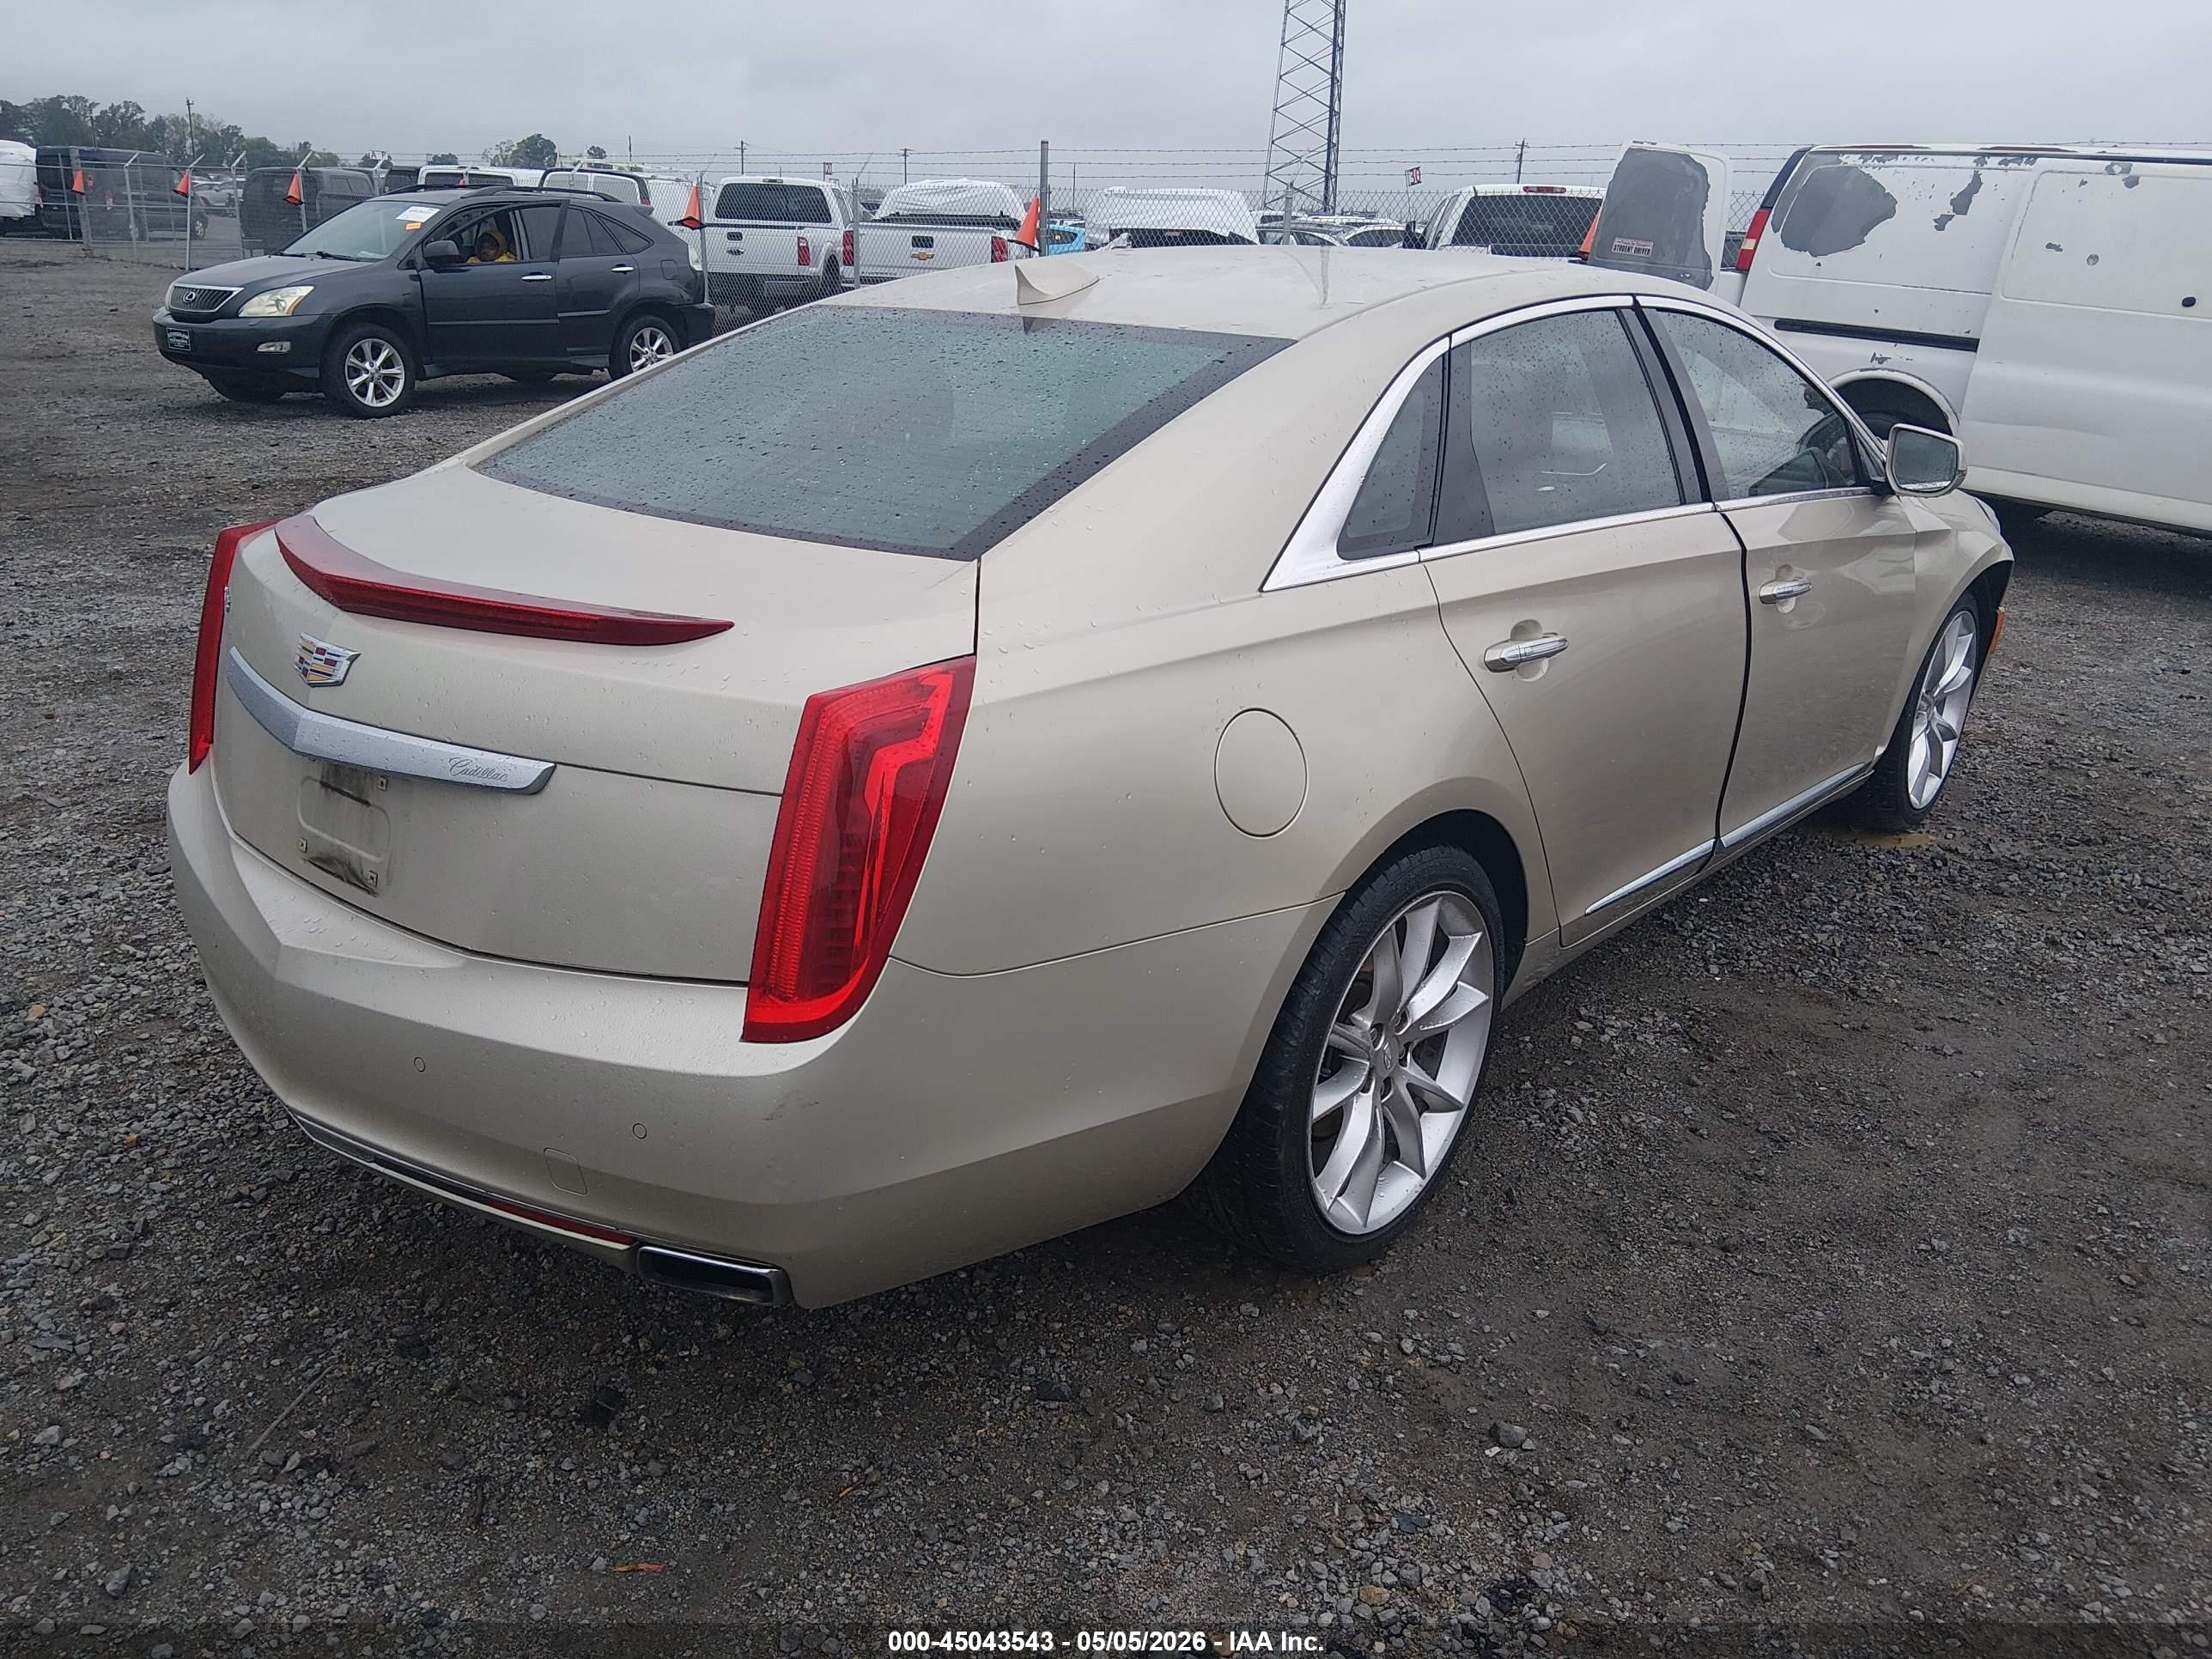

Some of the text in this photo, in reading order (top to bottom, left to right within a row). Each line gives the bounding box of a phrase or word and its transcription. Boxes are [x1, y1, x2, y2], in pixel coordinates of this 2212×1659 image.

[1410, 168, 1421, 184] 30
[1613, 244, 1633, 252] STUDENT
[447, 757, 508, 782] Cadillac
